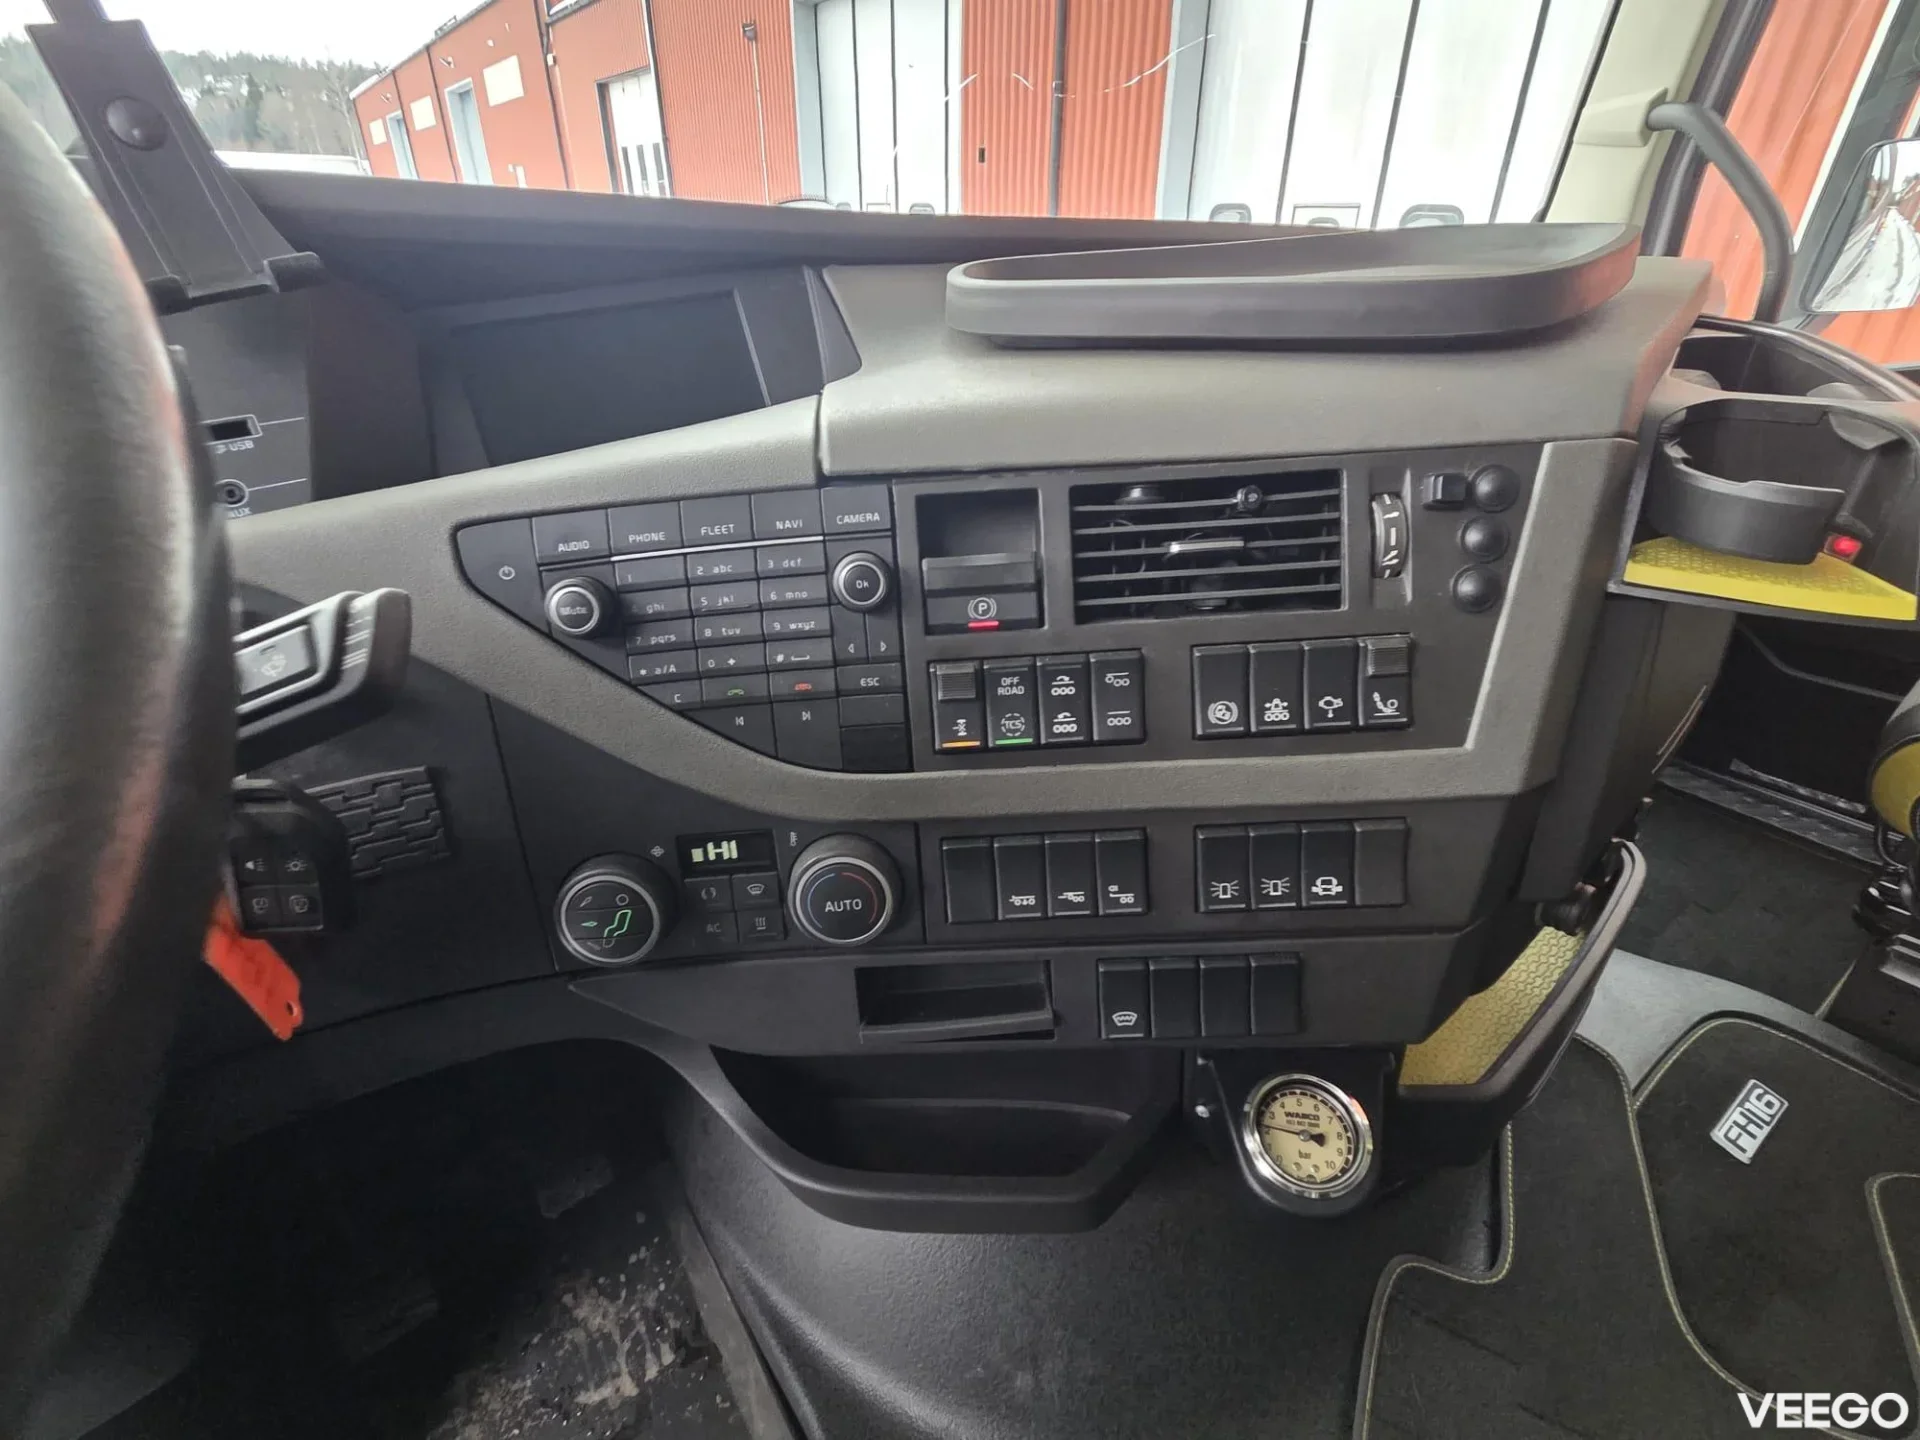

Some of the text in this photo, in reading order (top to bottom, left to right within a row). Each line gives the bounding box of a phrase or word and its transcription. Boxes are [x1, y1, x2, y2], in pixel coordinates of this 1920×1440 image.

[229, 440, 254, 451] USB
[836, 512, 881, 524] CAMERA
[775, 519, 803, 530] NAVI
[700, 524, 735, 536] FLEET
[628, 532, 666, 544] PHONE
[557, 540, 590, 552] AUDIO
[767, 558, 803, 569] 3 def
[697, 564, 733, 575] 2 abc
[770, 591, 808, 600] 6 mno
[701, 597, 708, 606] 5
[646, 604, 665, 614] ghi
[774, 620, 816, 631] 9 wxyz
[704, 627, 741, 637] 8 tuv
[636, 634, 677, 646] 7 pqrs
[654, 664, 677, 675] a/A
[860, 677, 881, 687] ESC
[1001, 676, 1020, 686] OFF
[997, 685, 1025, 696] ROAD
[674, 693, 681, 703] C
[1003, 719, 1023, 729] TCS
[824, 899, 863, 914] AUTO
[706, 923, 722, 934] AC
[1279, 1102, 1286, 1110] 4
[1296, 1098, 1303, 1107] 5
[1313, 1103, 1320, 1113] 6
[1269, 1111, 1275, 1120] 3
[1284, 1111, 1320, 1121] WABCO
[1327, 1116, 1334, 1125] 7
[1723, 1088, 1781, 1154] FH16
[1336, 1131, 1343, 1140] 8
[1299, 1149, 1312, 1160] bar
[1336, 1149, 1343, 1157] 9
[1325, 1160, 1337, 1170] 10
